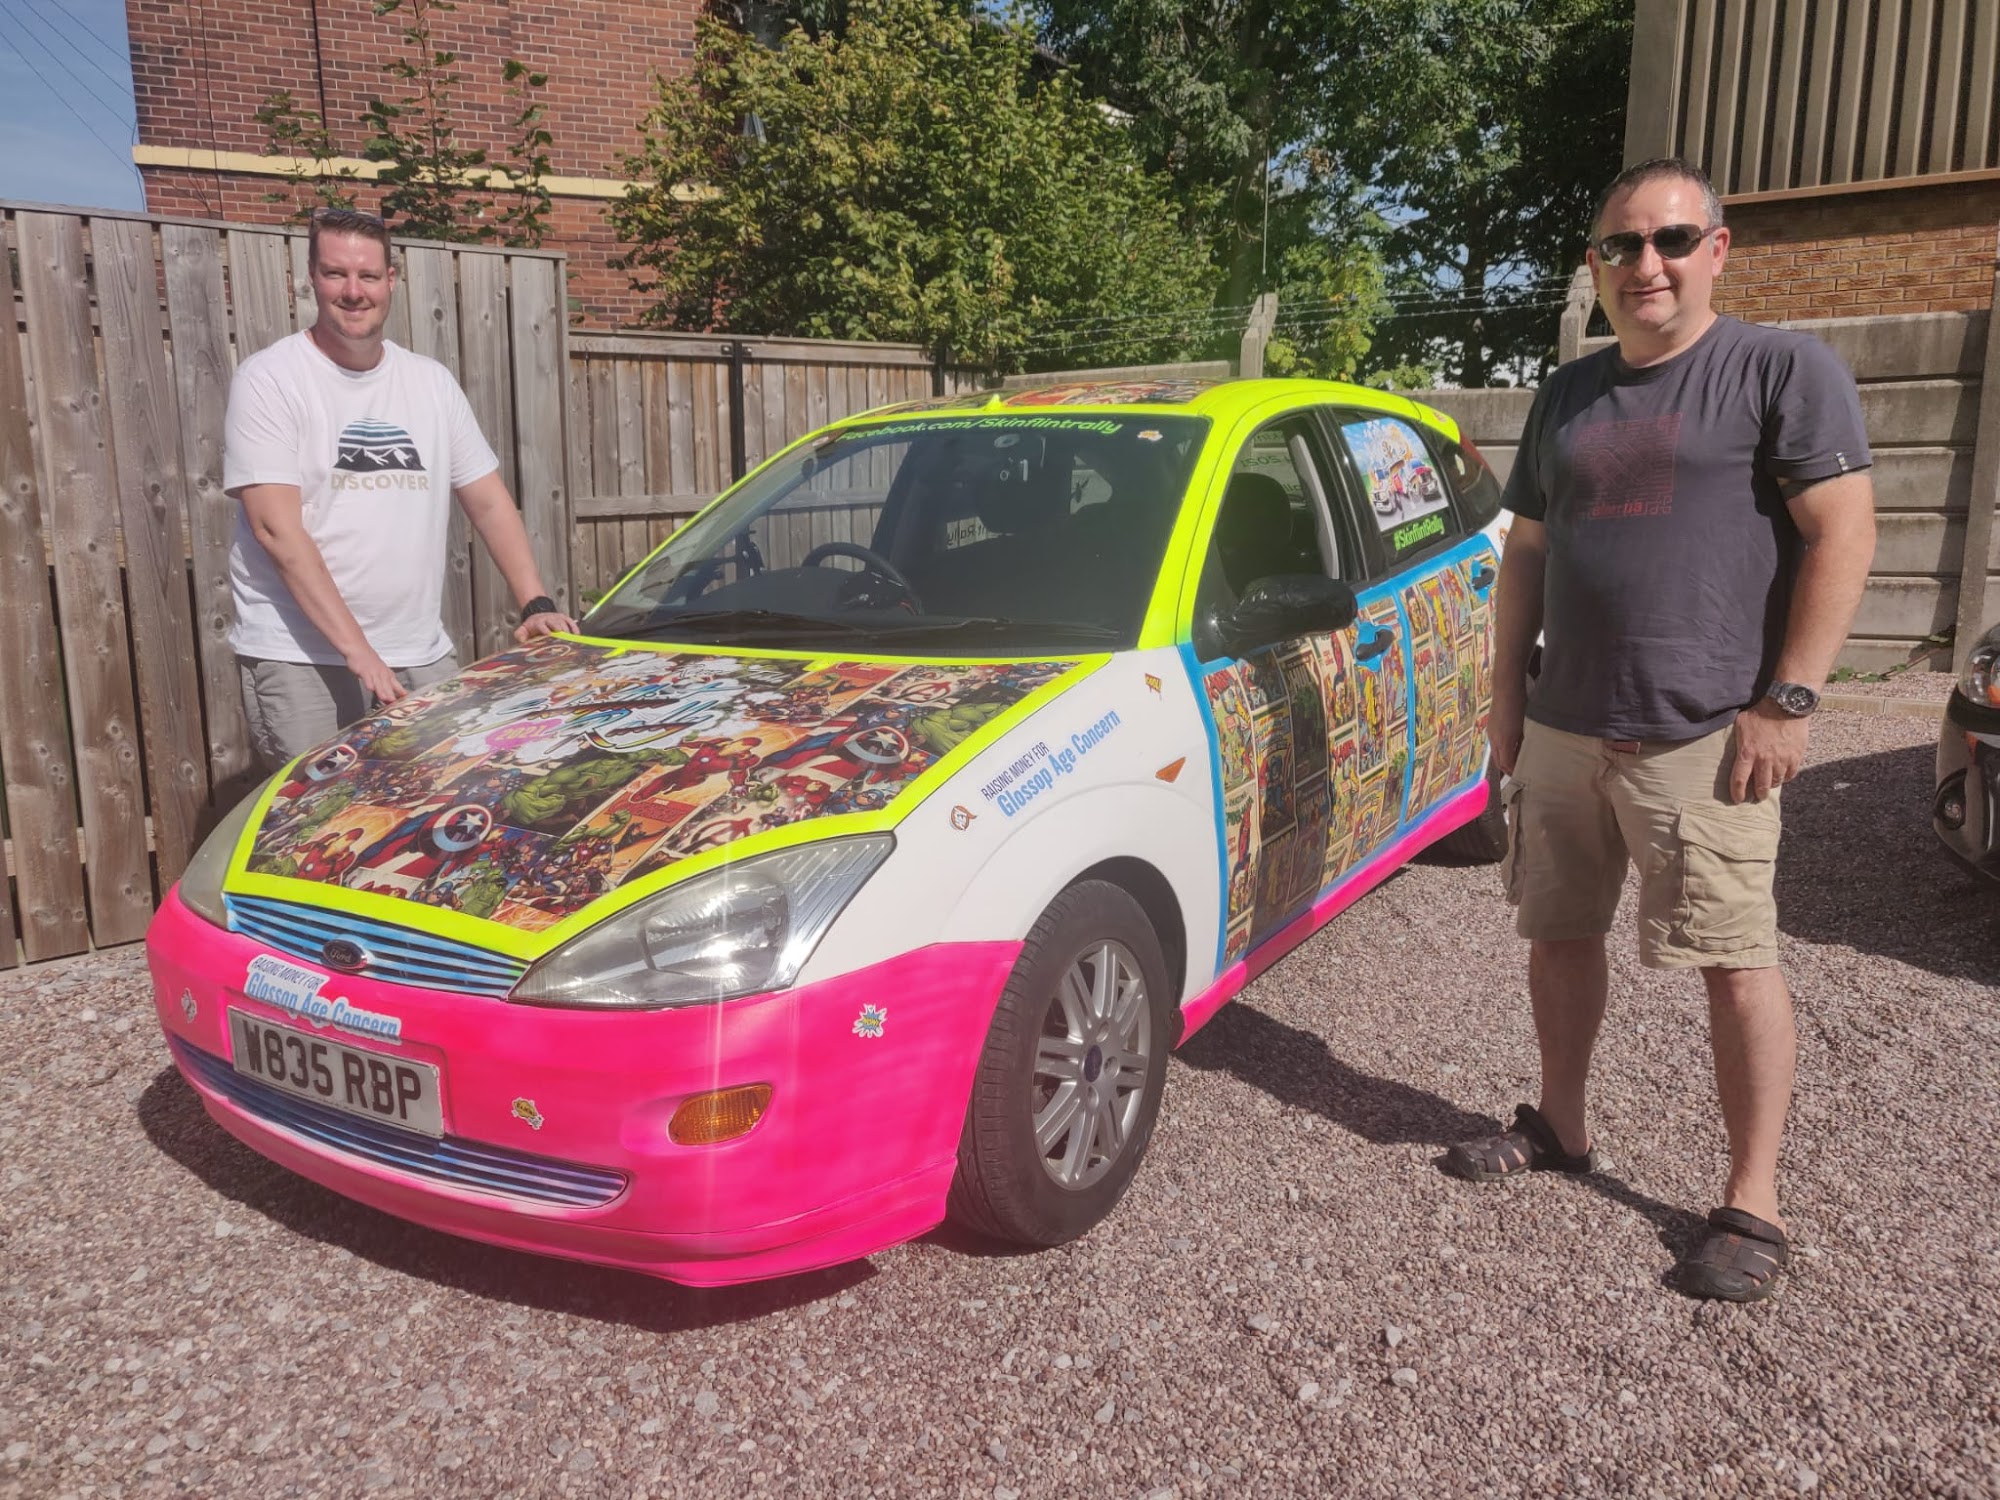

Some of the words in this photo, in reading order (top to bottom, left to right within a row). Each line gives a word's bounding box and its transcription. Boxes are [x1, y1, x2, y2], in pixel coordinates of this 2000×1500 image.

[330, 473, 429, 491] DISCOVER
[981, 771, 1014, 801] RAISING
[1011, 752, 1036, 777] MONEY
[1033, 742, 1050, 762] FOR
[996, 768, 1054, 818] Glossop
[1048, 747, 1077, 774] Age
[1071, 710, 1121, 755] Concern
[252, 957, 278, 976] RAISING
[277, 964, 304, 985] MONEY
[304, 975, 325, 992] FOR
[332, 1002, 398, 1036] Concern
[243, 1019, 334, 1097] W835
[341, 1052, 421, 1120] RBP
